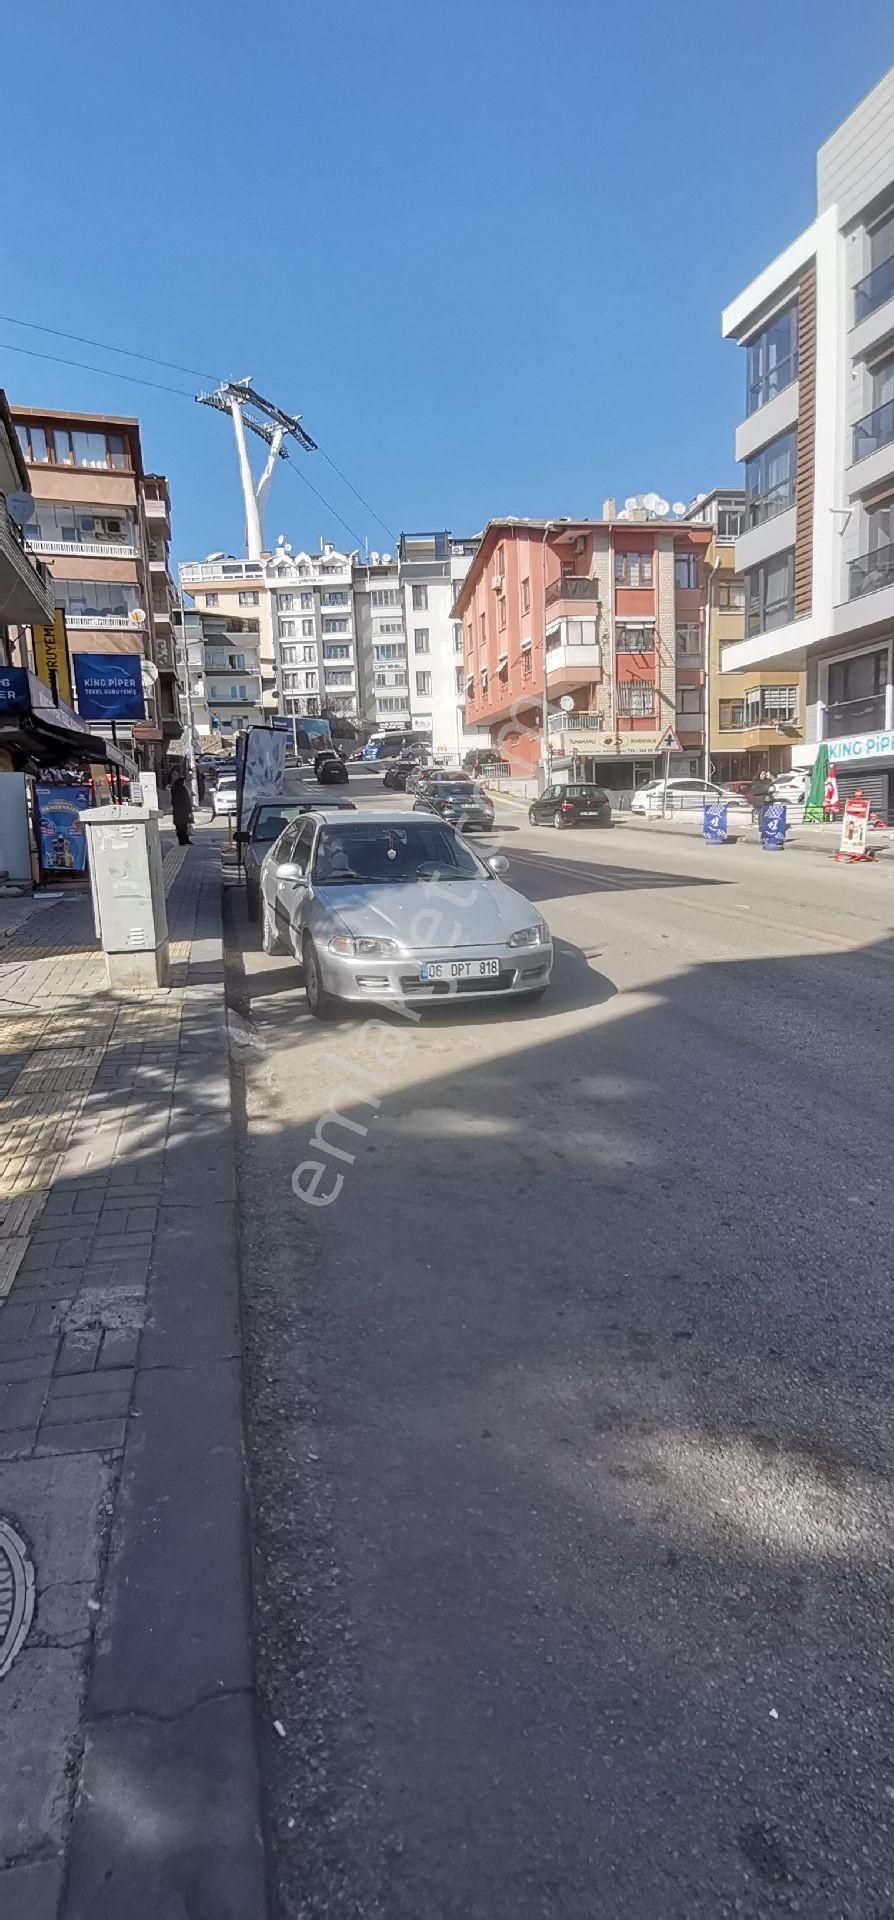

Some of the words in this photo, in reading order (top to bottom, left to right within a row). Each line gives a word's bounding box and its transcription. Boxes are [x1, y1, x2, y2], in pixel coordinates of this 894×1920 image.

[428, 964, 443, 977] 06
[451, 963, 471, 977] DPT
[479, 960, 497, 974] 818
